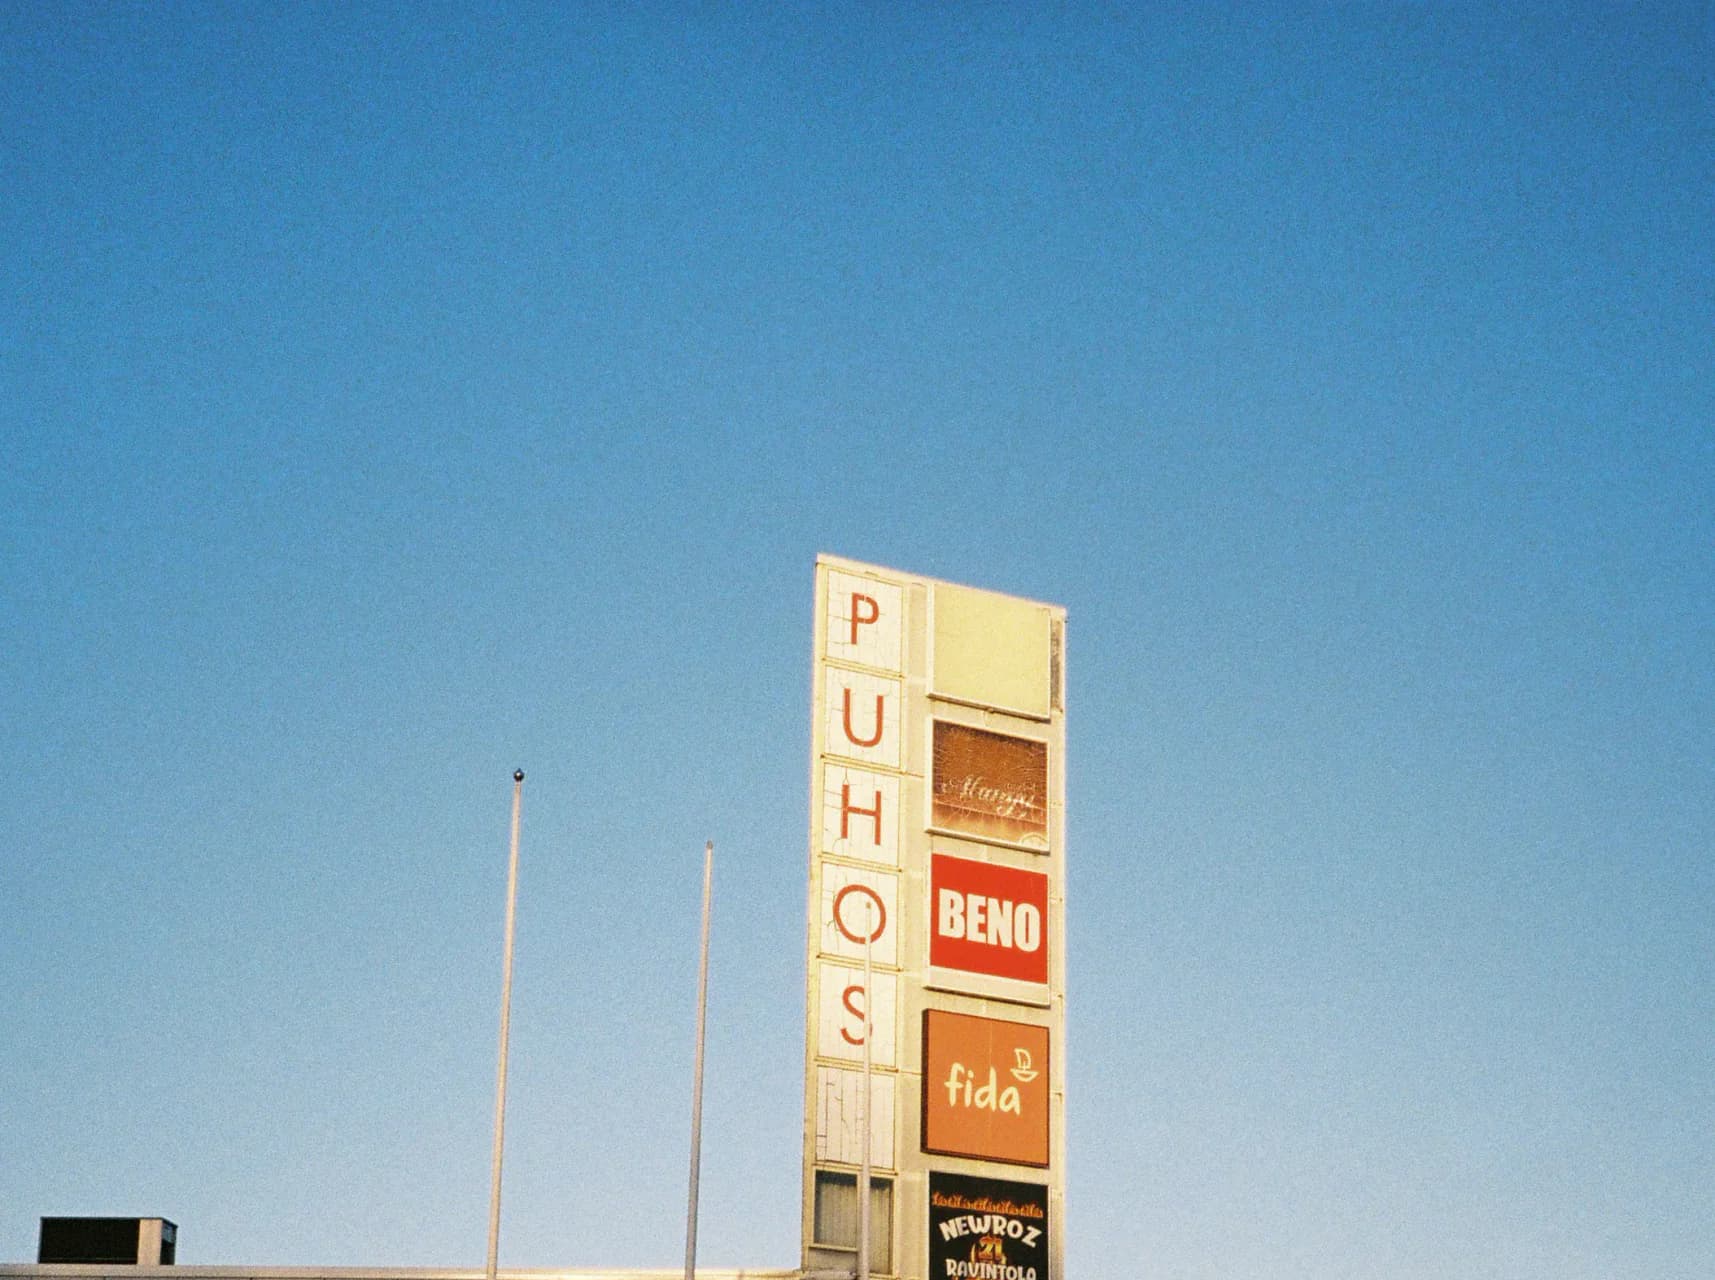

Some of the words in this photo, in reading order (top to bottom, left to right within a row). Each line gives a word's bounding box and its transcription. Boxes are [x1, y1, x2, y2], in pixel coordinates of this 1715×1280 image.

[833, 592, 887, 1046] PUHOS
[938, 888, 1041, 952] BENO
[944, 1062, 1021, 1115] fida
[938, 1214, 1042, 1248] NEWROZ
